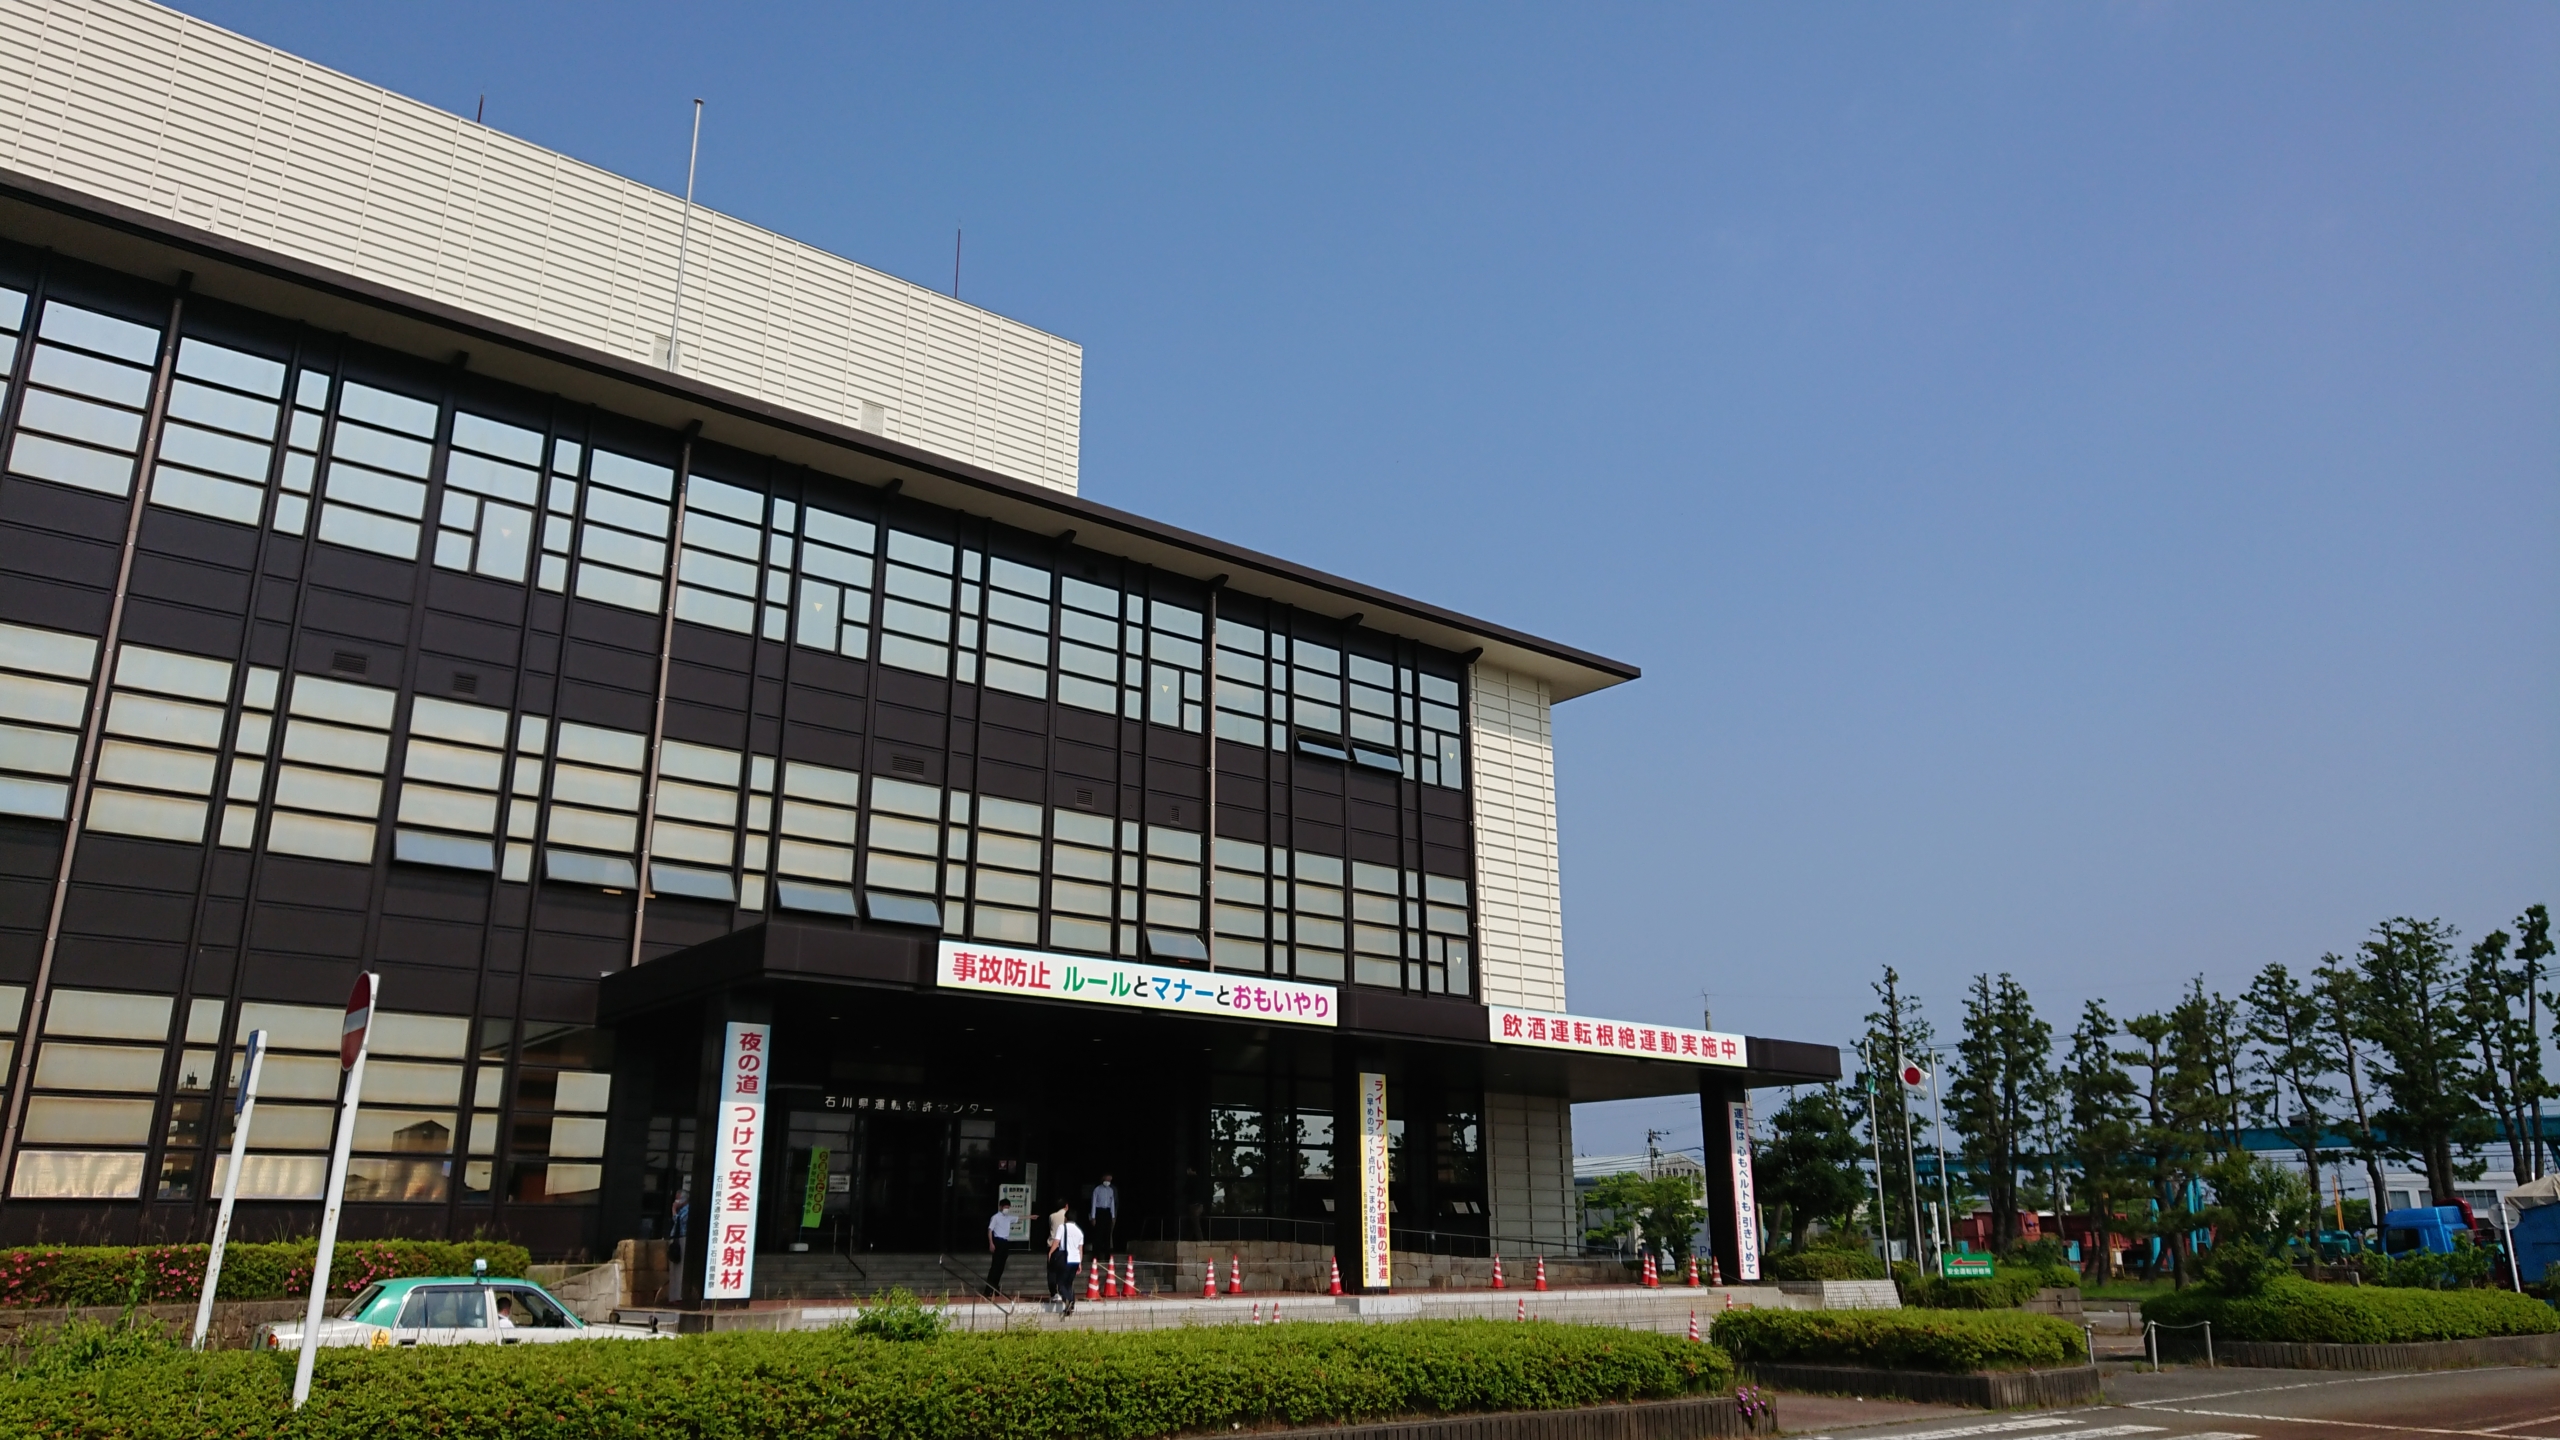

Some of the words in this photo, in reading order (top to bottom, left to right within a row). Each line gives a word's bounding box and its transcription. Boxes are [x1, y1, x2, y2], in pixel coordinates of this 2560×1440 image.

[952, 952, 1052, 990] 事故防止
[1062, 965, 1330, 1018] ルールとマナーとおもいやり
[736, 1032, 763, 1095] 夜の道
[1502, 1012, 1737, 1060] 飲酒運転根絶運動実施中
[824, 1096, 994, 1114] 石川県運転免許センター
[1733, 1108, 1746, 1141] 運転は
[726, 1106, 756, 1212] つけて安全
[1374, 1080, 1389, 1280] ライトアップいしかわ運動の推進
[1737, 1146, 1751, 1212] 心もベルトも
[720, 1224, 748, 1290] 反射材
[1742, 1216, 1756, 1274] 引きしめて
